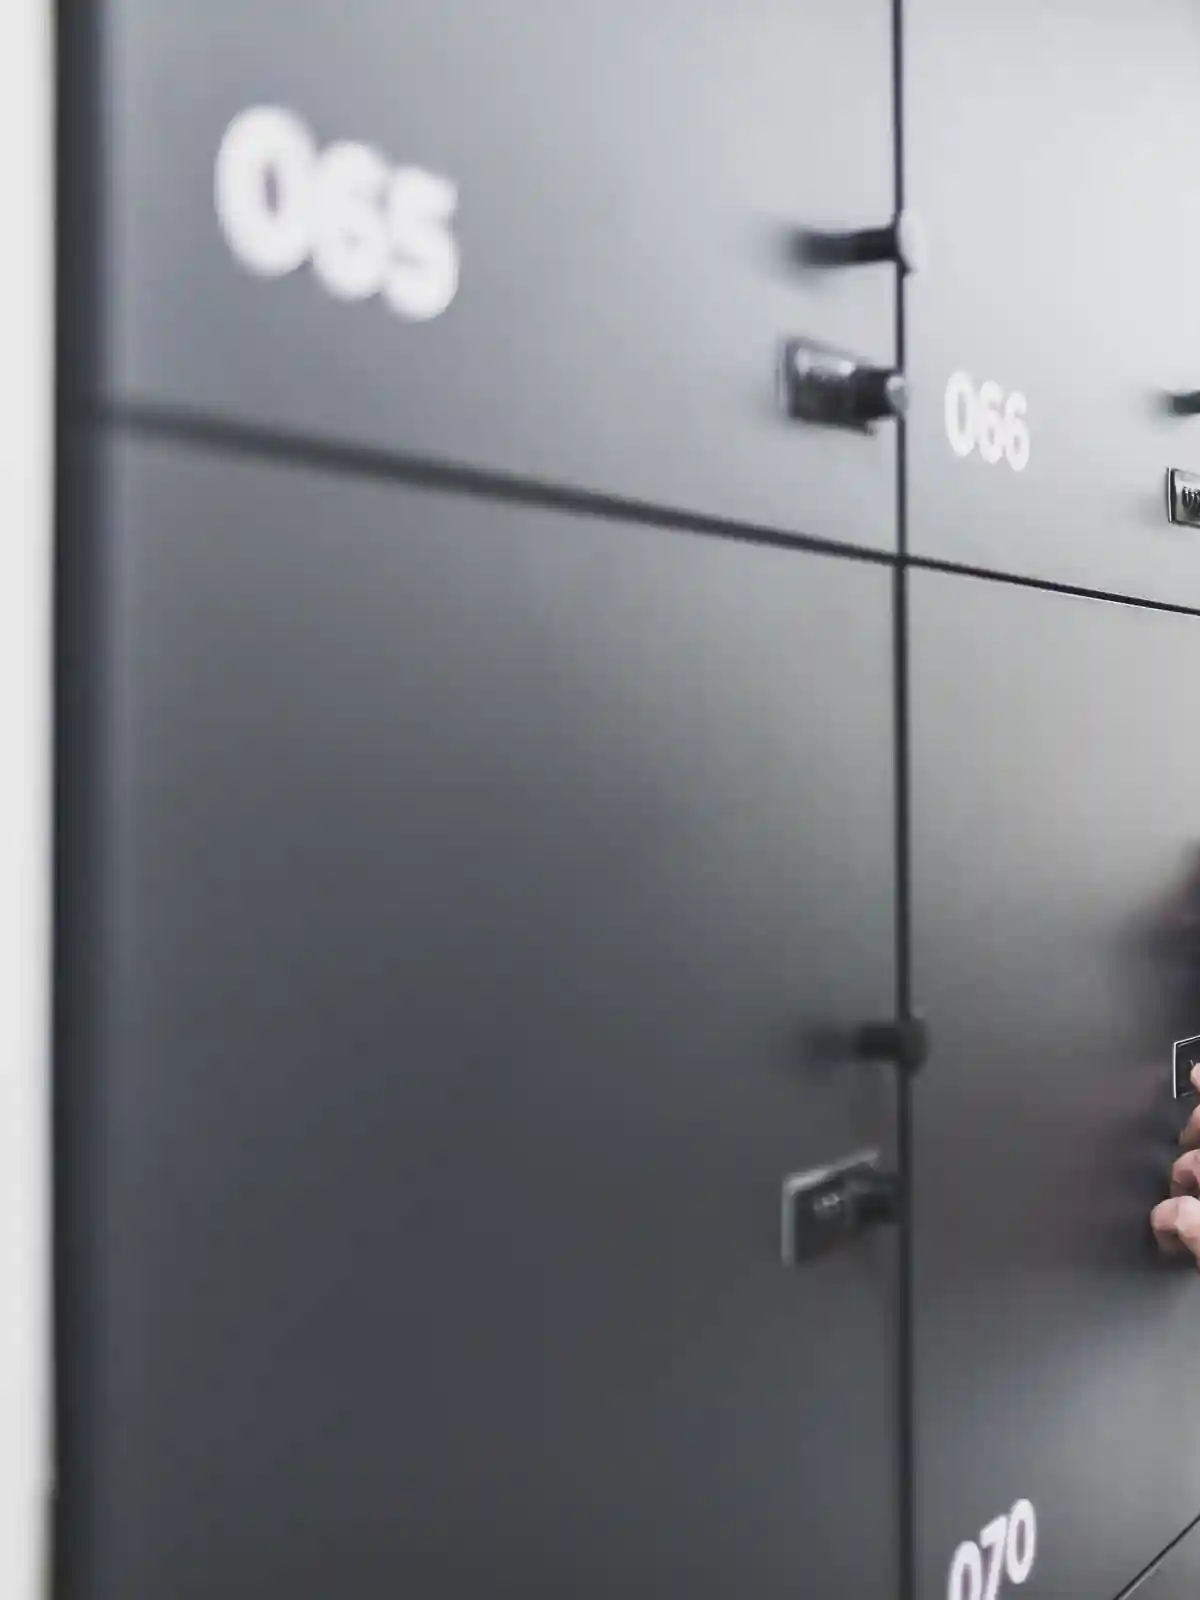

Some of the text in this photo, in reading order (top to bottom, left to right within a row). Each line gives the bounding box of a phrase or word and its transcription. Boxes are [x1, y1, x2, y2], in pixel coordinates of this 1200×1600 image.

[214, 105, 458, 321] 065
[944, 369, 1030, 472] 066
[948, 1498, 1036, 1600] 070
